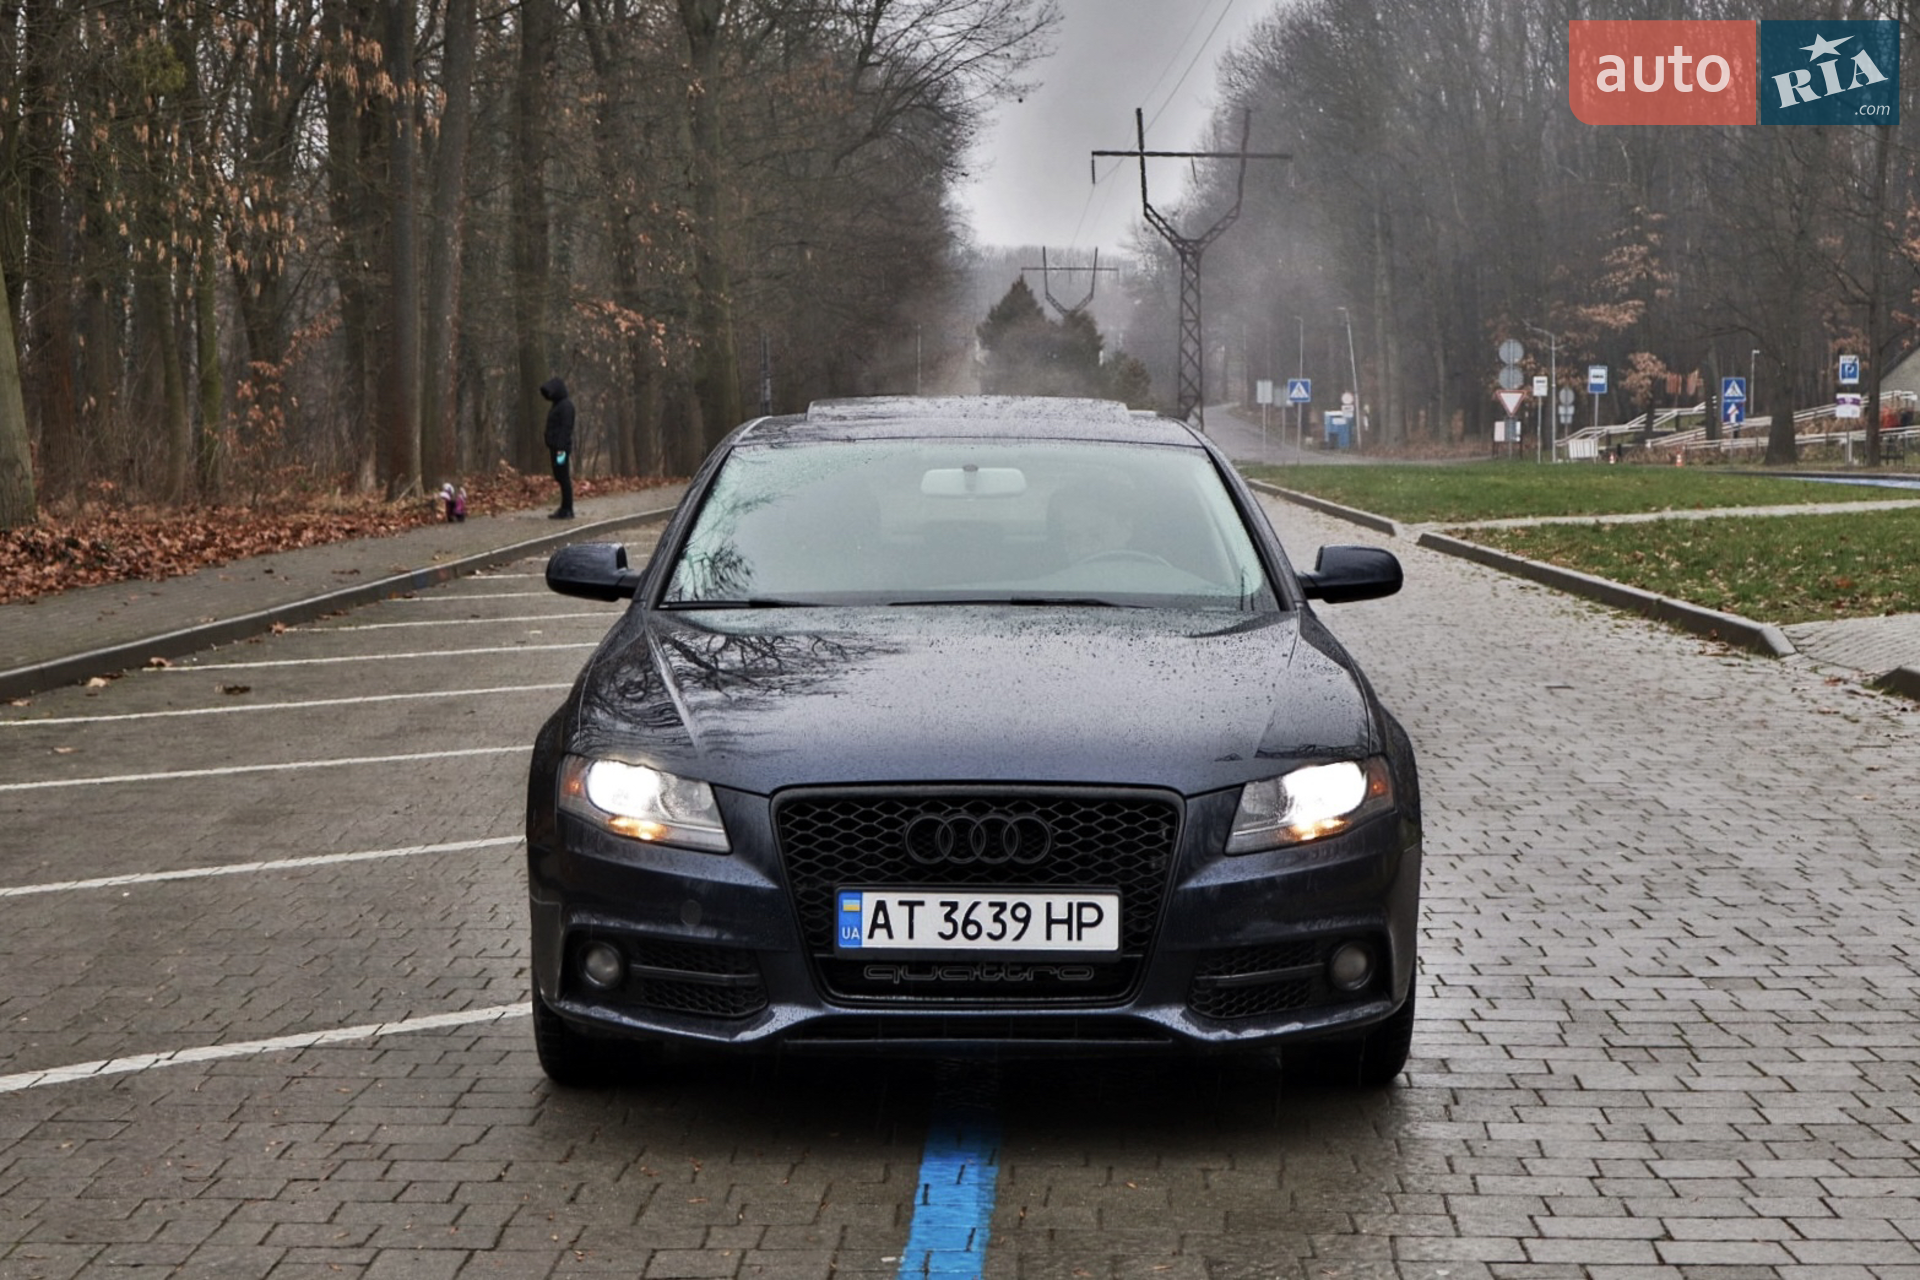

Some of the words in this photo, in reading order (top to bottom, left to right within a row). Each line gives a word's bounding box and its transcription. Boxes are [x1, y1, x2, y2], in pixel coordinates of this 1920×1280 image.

[867, 899, 925, 940] AT
[937, 901, 1032, 942] 3639
[1045, 901, 1104, 942] HP
[841, 926, 860, 940] UA
[863, 964, 1095, 984] quattro
